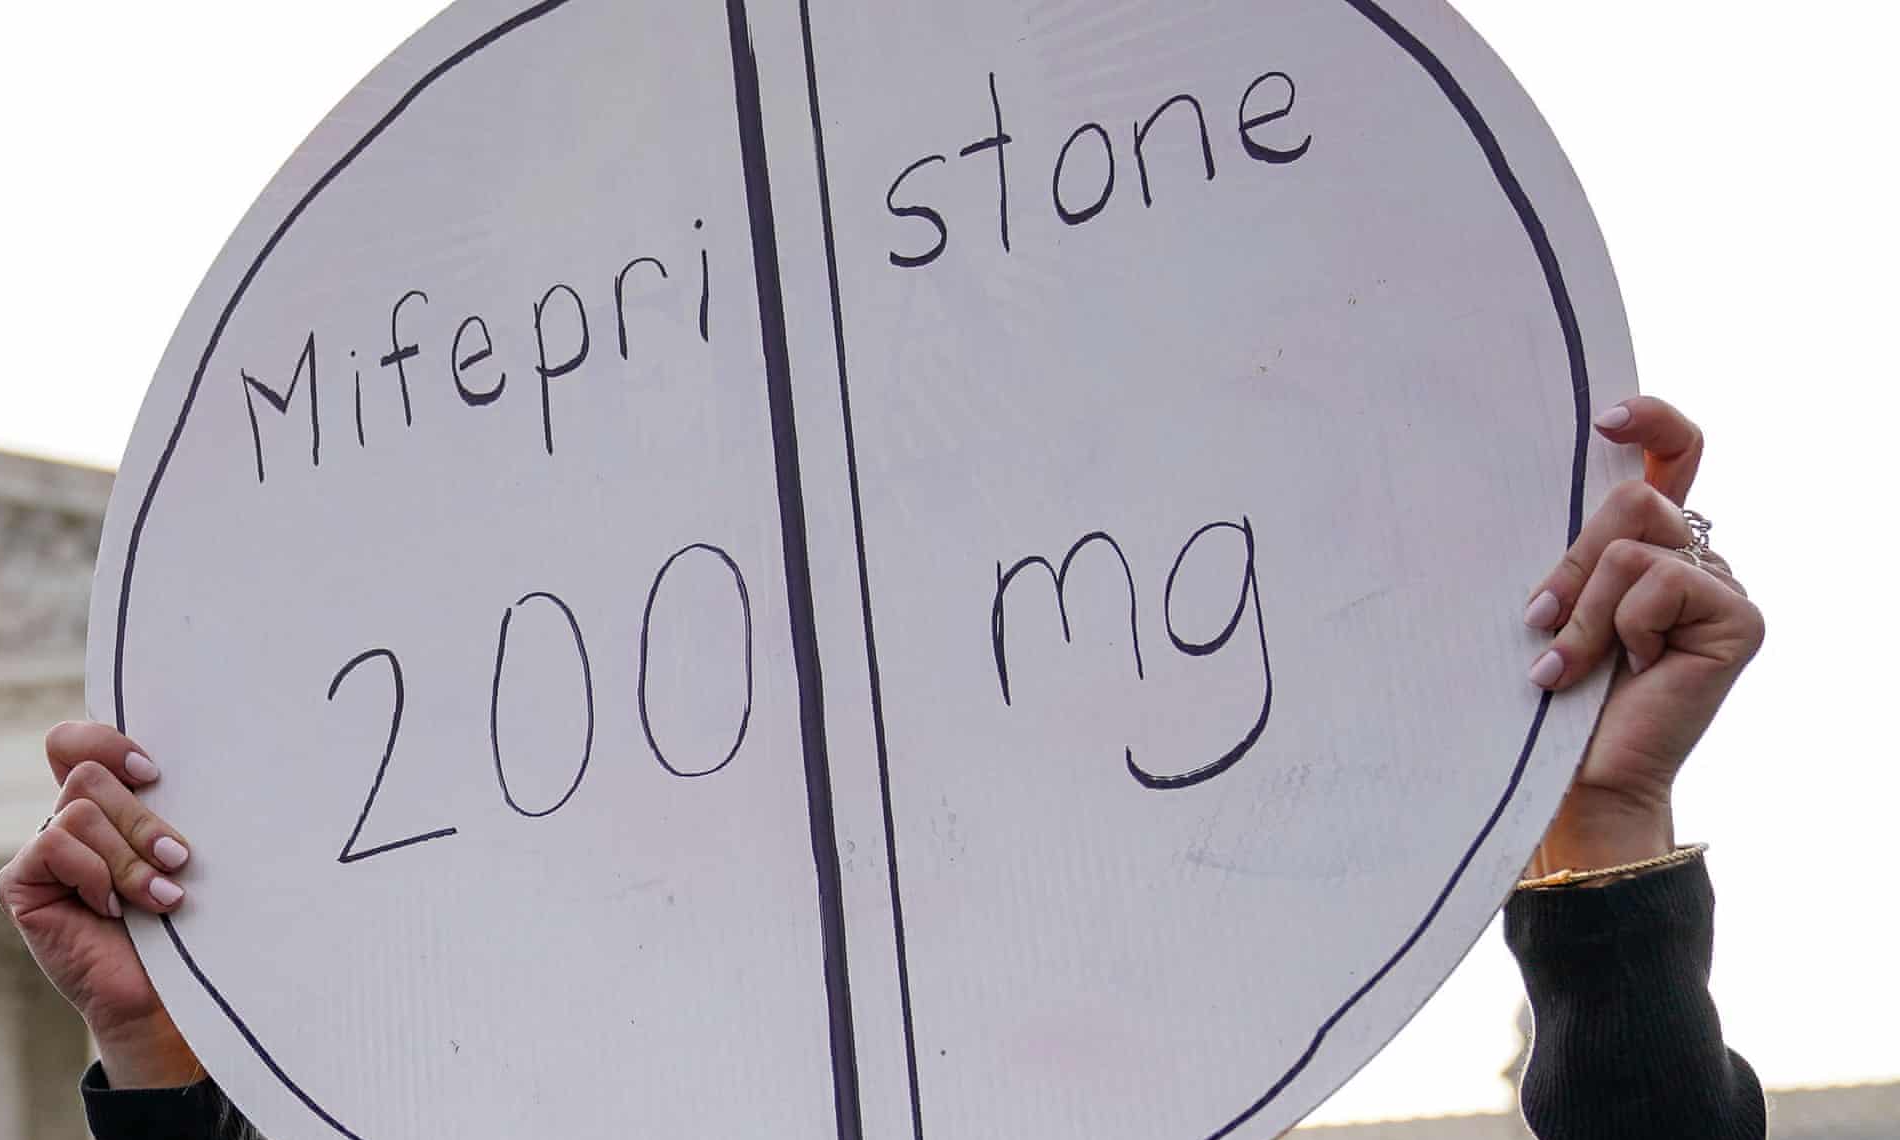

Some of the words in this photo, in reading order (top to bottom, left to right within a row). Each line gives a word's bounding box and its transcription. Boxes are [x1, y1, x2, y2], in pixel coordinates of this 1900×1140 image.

[241, 218, 711, 484] Mifepri
[886, 71, 1313, 269] stone
[327, 542, 754, 864] 200
[990, 514, 1274, 790] mg
